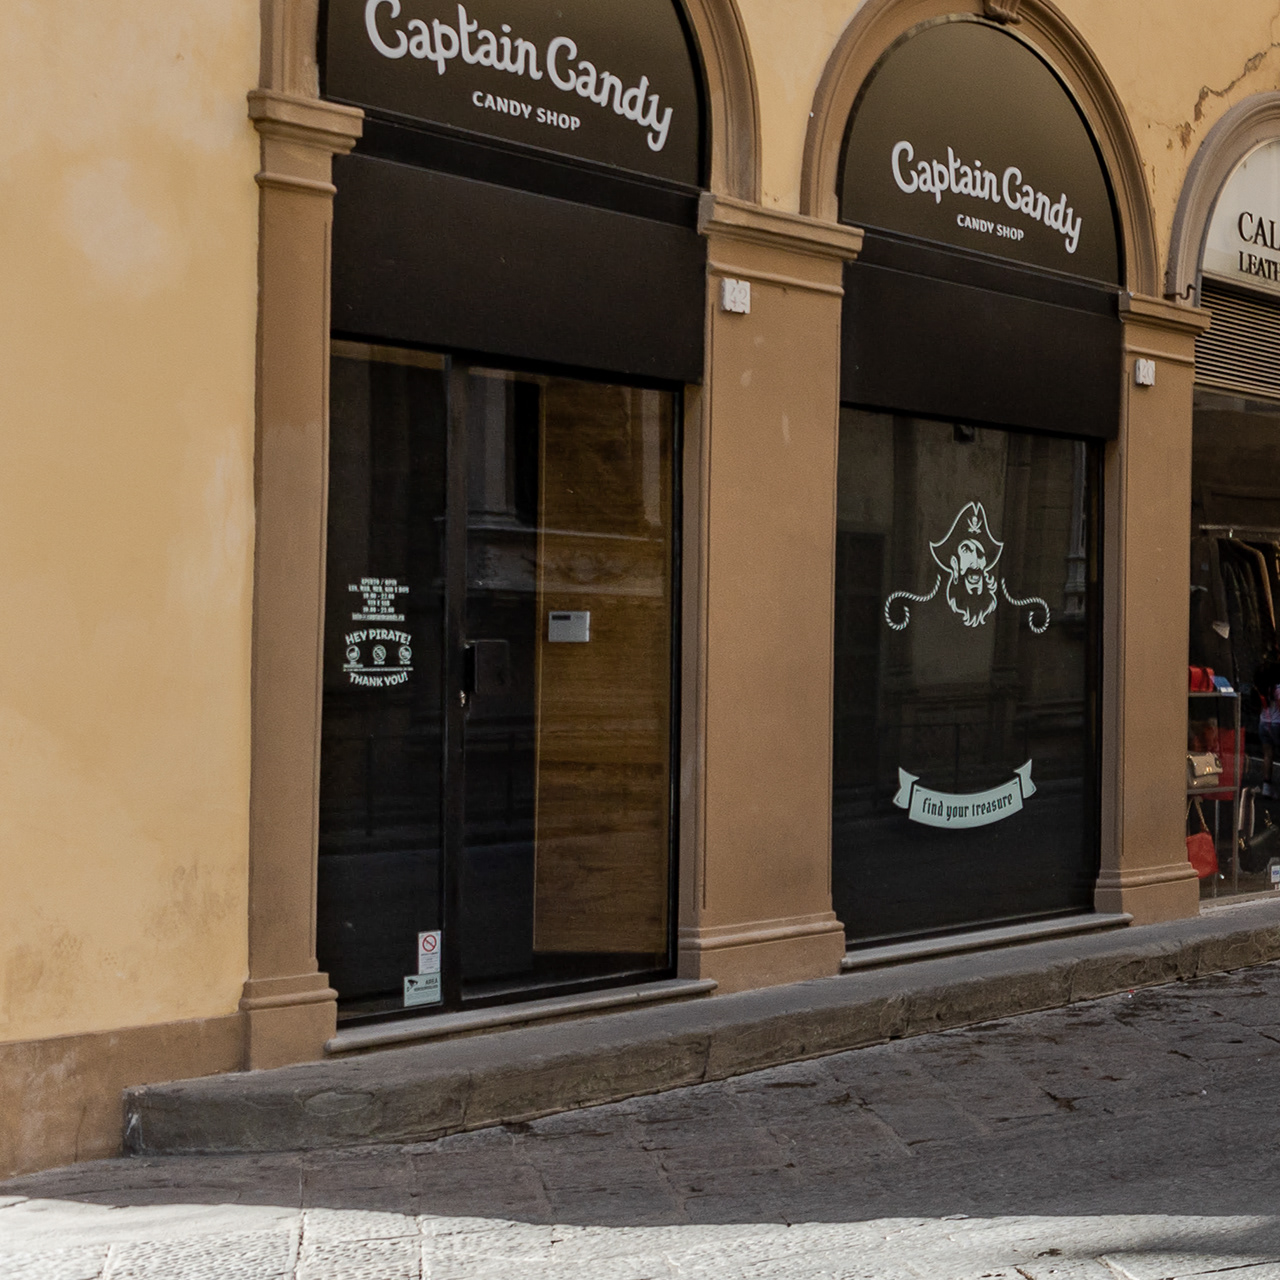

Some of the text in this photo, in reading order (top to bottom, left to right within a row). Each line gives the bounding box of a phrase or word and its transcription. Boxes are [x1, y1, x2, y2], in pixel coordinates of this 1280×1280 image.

[546, 36, 673, 152] Candy
[471, 90, 581, 131] CANDY SHOP
[891, 140, 1082, 254] Captain Candy
[956, 213, 1025, 241] CANDY SHOP
[345, 628, 412, 645] HEY PIRATE!
[350, 671, 409, 687] THANK YOU!
[922, 793, 1013, 821] find your treasure
